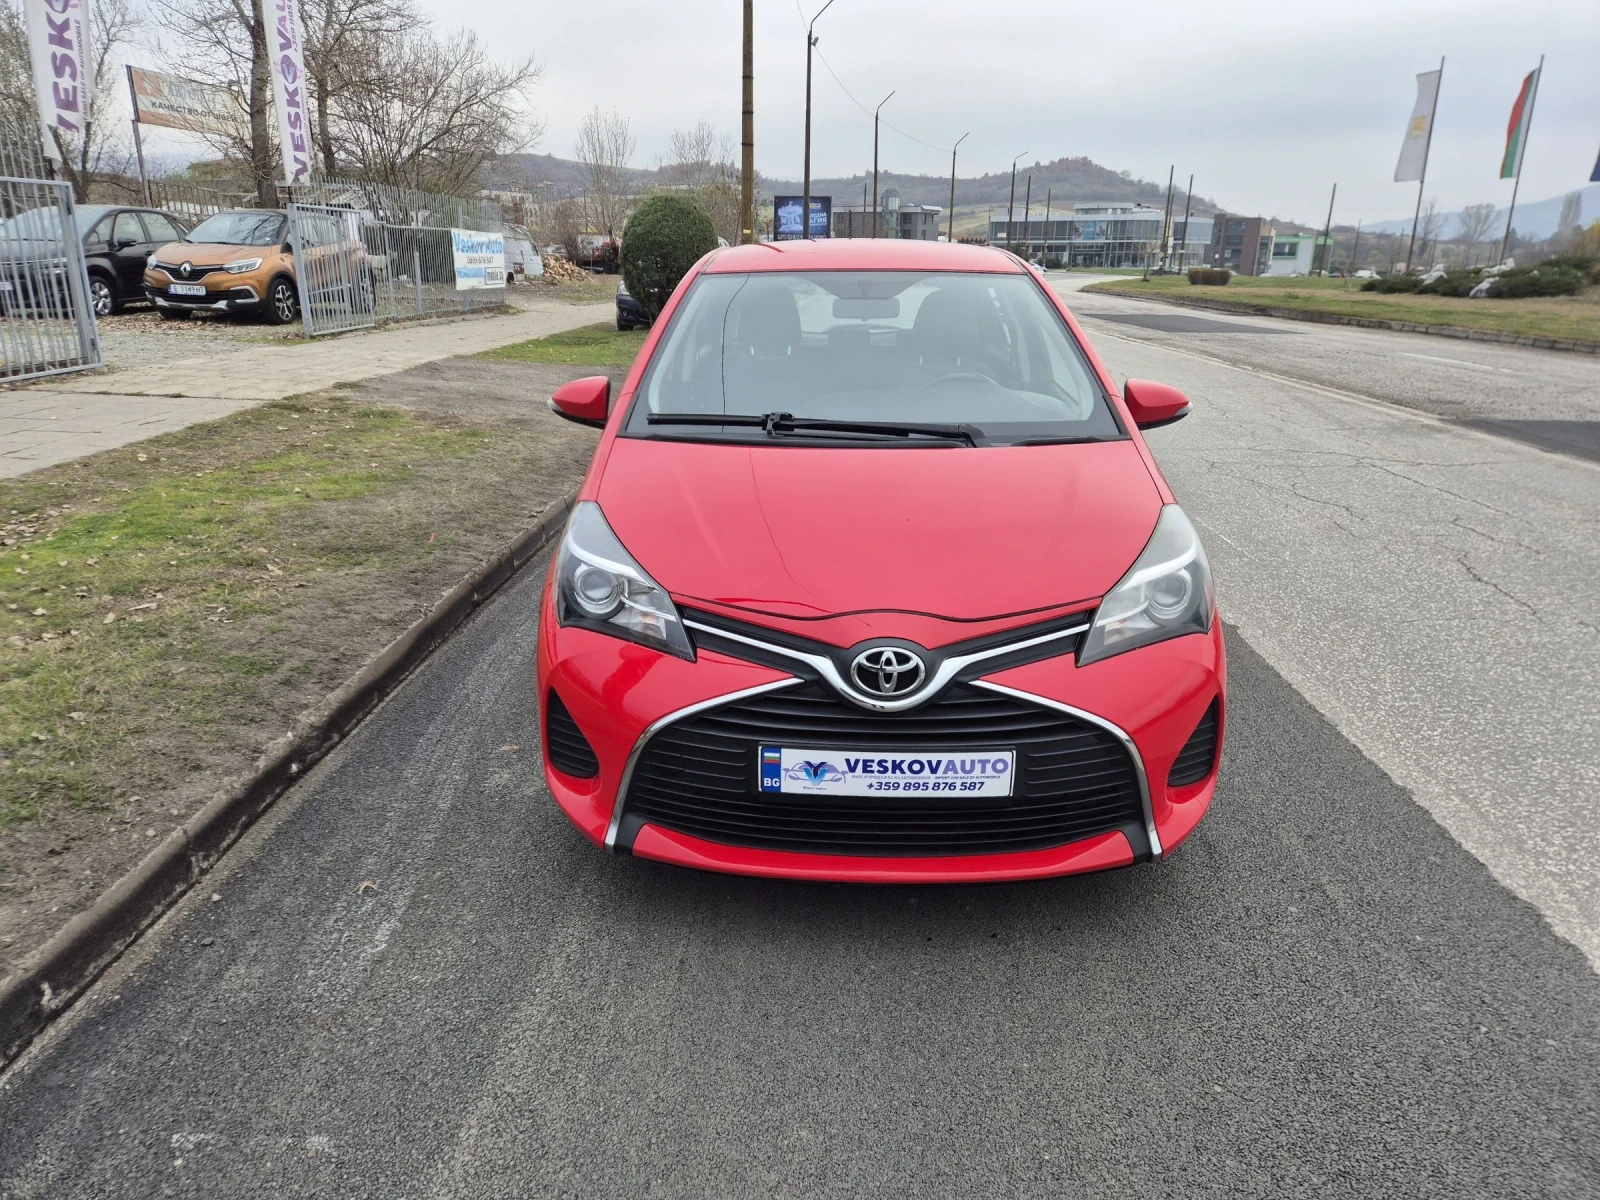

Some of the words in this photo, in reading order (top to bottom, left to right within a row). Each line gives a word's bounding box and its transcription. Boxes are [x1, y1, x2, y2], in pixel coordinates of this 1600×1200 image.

[74, 19, 84, 69] AUTOMOBILE
[151, 101, 200, 116] КАЧЕСТВО
[844, 758, 1009, 775] VESKOVAUTO
[763, 777, 780, 787] BG
[867, 781, 901, 791] +359
[903, 781, 929, 791] 895
[931, 782, 957, 791] 876
[959, 781, 985, 791] 587
